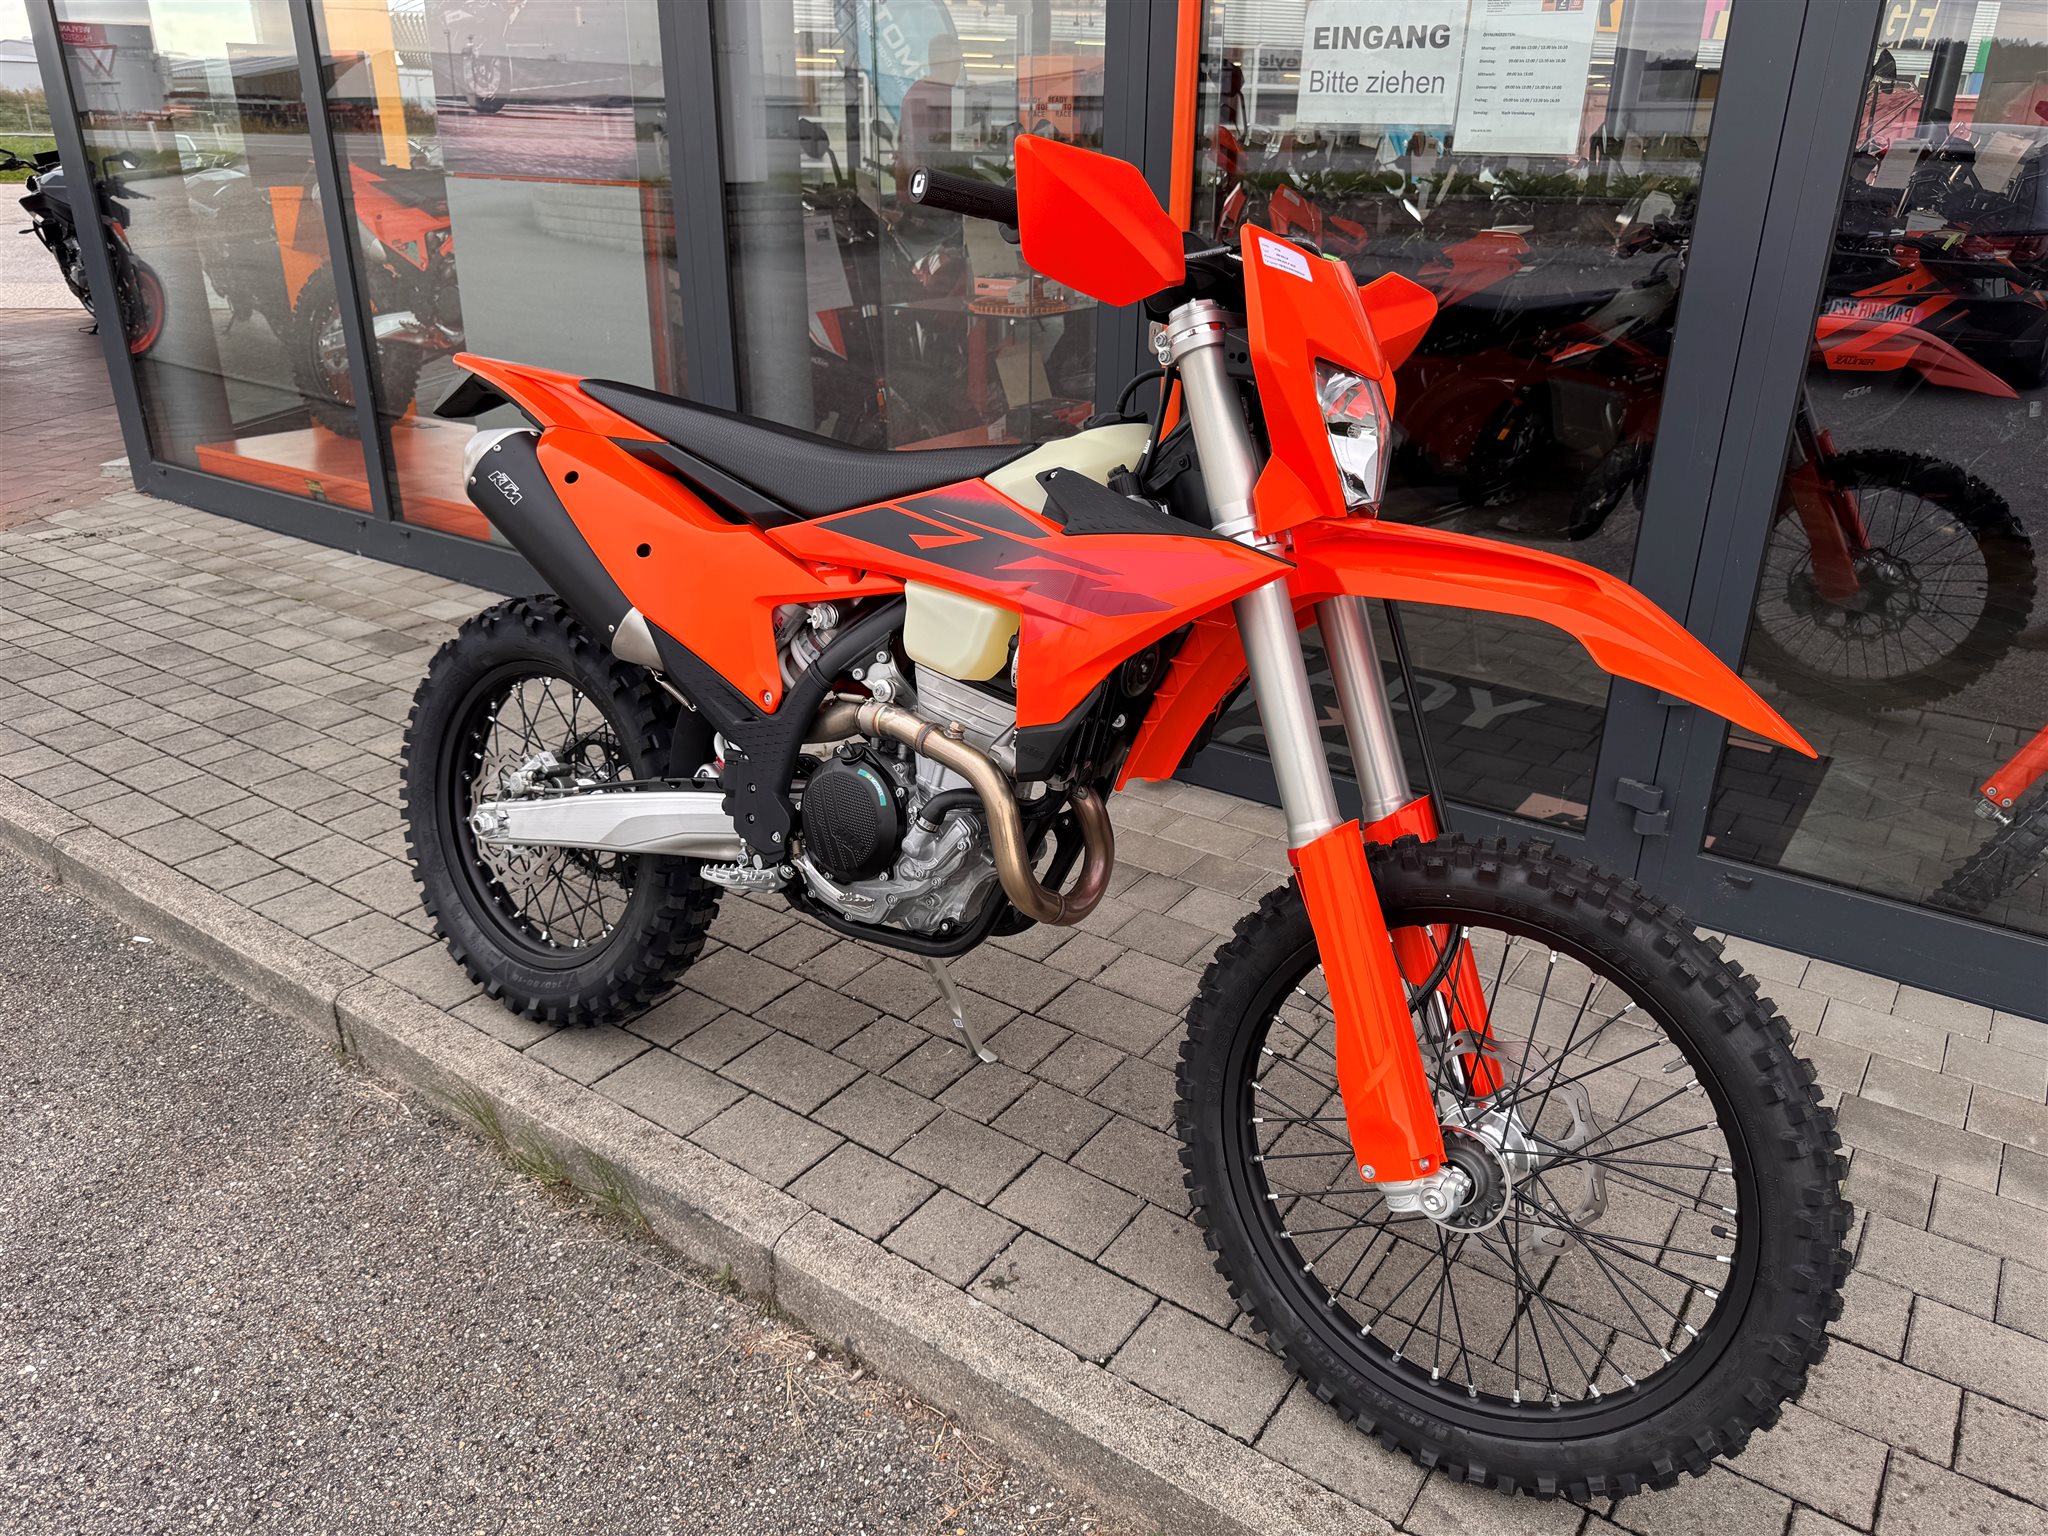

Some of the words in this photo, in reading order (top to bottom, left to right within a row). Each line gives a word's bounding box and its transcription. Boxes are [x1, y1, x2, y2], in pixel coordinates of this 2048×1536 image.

[1313, 24, 1451, 50] EINGANG
[1309, 70, 1359, 93] Bitte
[1366, 70, 1445, 94] ziehen
[487, 470, 523, 506] KTM
